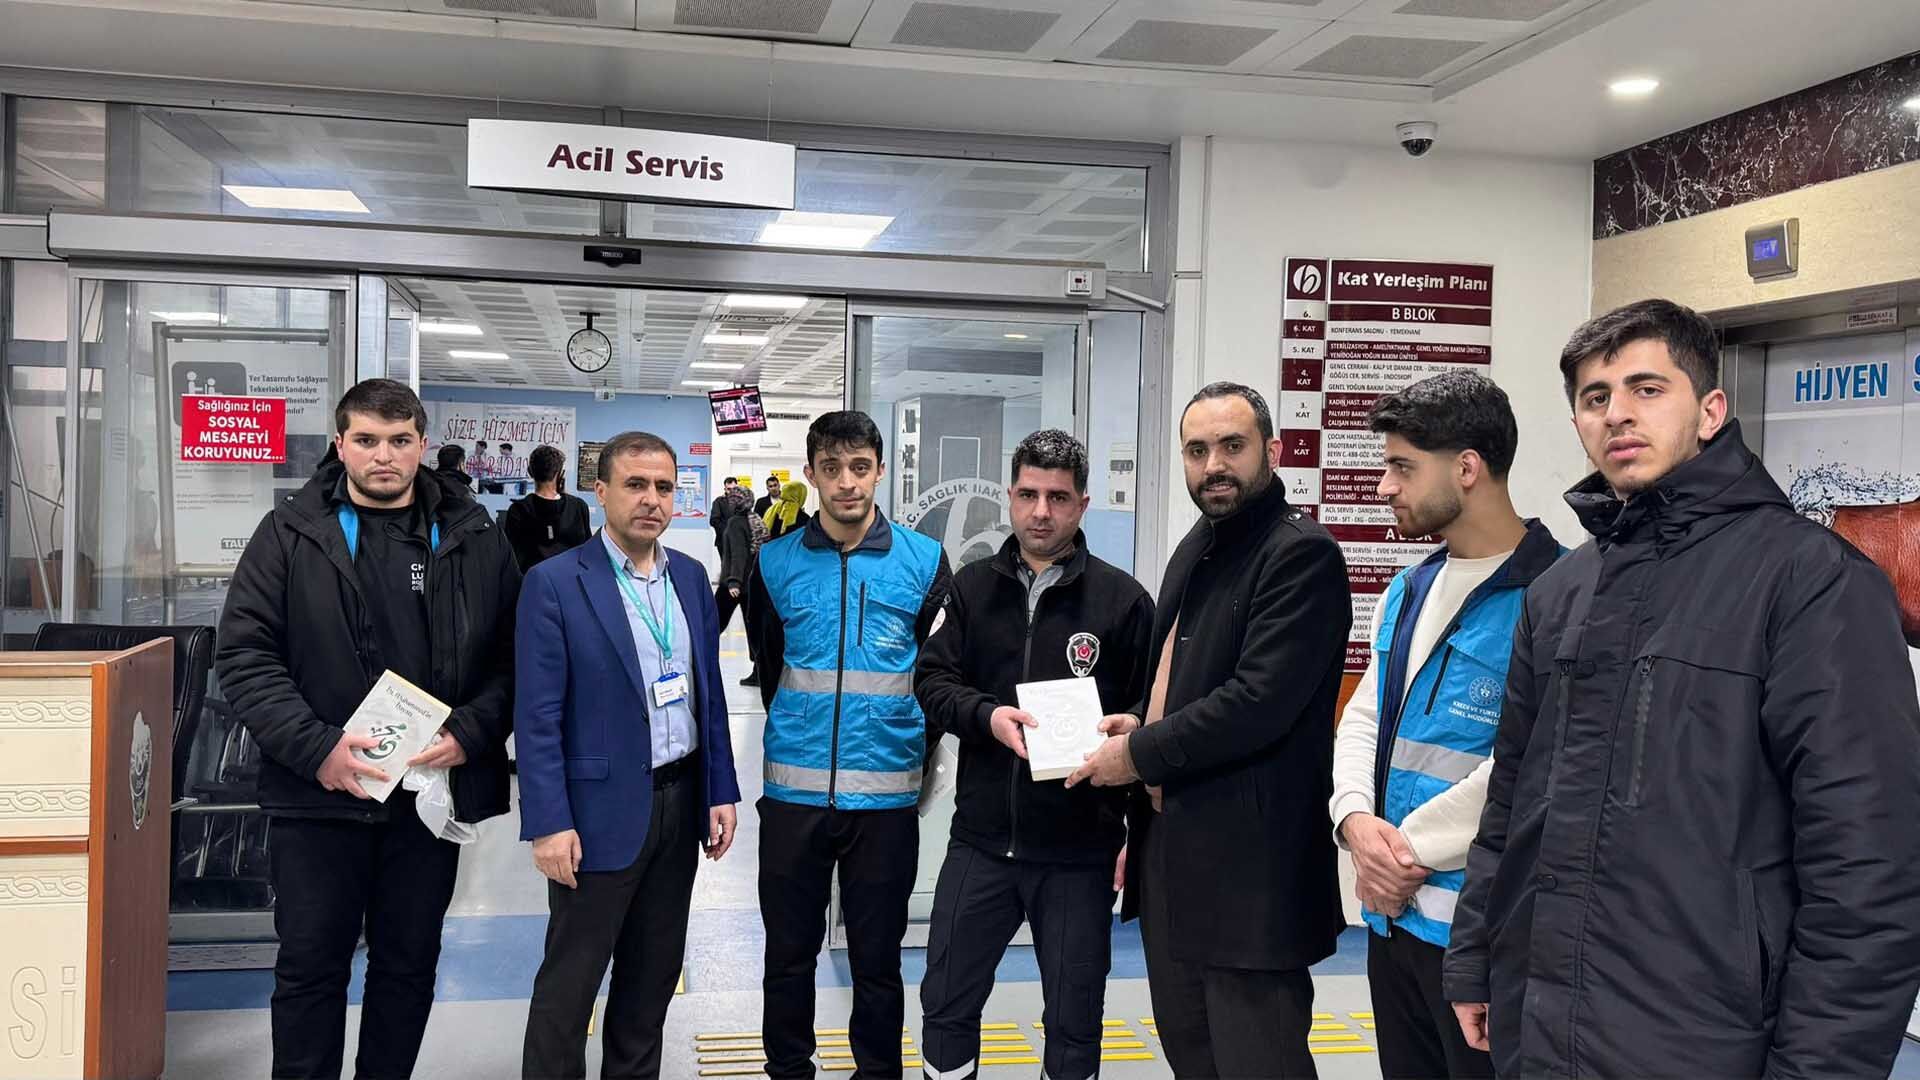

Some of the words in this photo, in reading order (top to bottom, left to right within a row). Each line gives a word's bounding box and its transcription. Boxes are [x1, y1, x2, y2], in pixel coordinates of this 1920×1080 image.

[547, 144, 613, 172] Acil
[626, 150, 723, 181] Servis
[1338, 271, 1368, 286] Kat
[1373, 272, 1444, 291] Yerleşim
[1449, 275, 1487, 291] Planı
[1303, 311, 1312, 319] 6.
[1392, 308, 1400, 320] B
[1404, 308, 1436, 321] BLOK
[1292, 346, 1300, 354] 5.
[1301, 369, 1309, 377] 4.
[1795, 362, 1887, 402] HİJYEN
[198, 400, 249, 413] Sağlığınız
[252, 400, 271, 414] İçin
[1296, 411, 1310, 419] KAT
[209, 416, 260, 429] SOSYAL
[444, 414, 478, 440] SİZE
[482, 415, 539, 442] HİZMET
[539, 417, 569, 445] İÇİN
[199, 430, 269, 444] MESAFEYİ
[184, 447, 283, 461] KORUYUNUZ...
[1385, 528, 1396, 540] A
